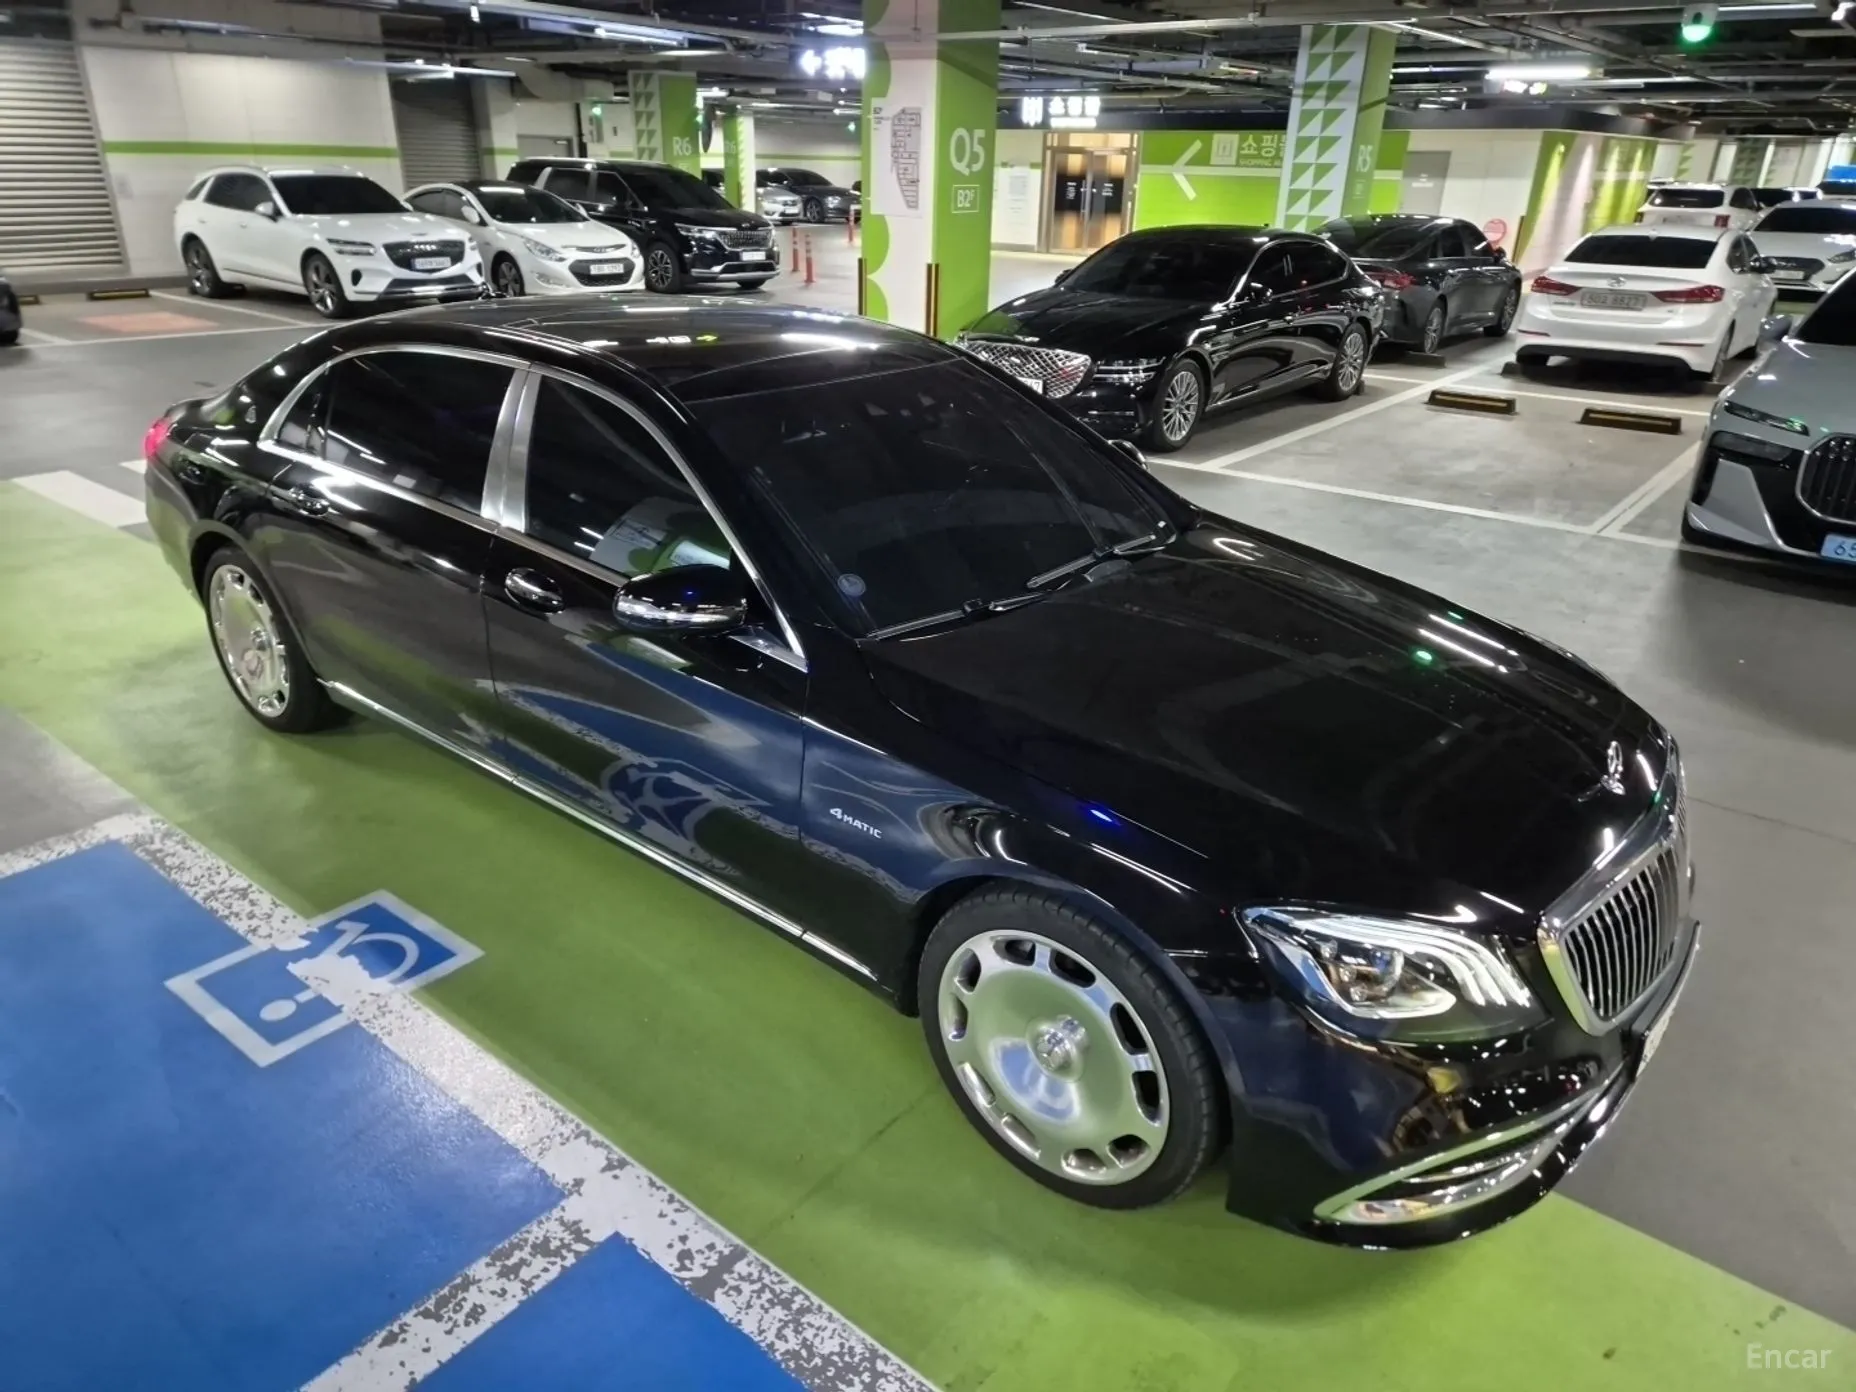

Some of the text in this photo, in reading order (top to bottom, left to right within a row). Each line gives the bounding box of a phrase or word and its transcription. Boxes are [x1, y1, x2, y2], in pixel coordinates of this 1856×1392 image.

[672, 136, 693, 156] R6
[949, 127, 985, 176] Q5
[1356, 144, 1374, 172] R5
[829, 807, 882, 839] 4MATIC
